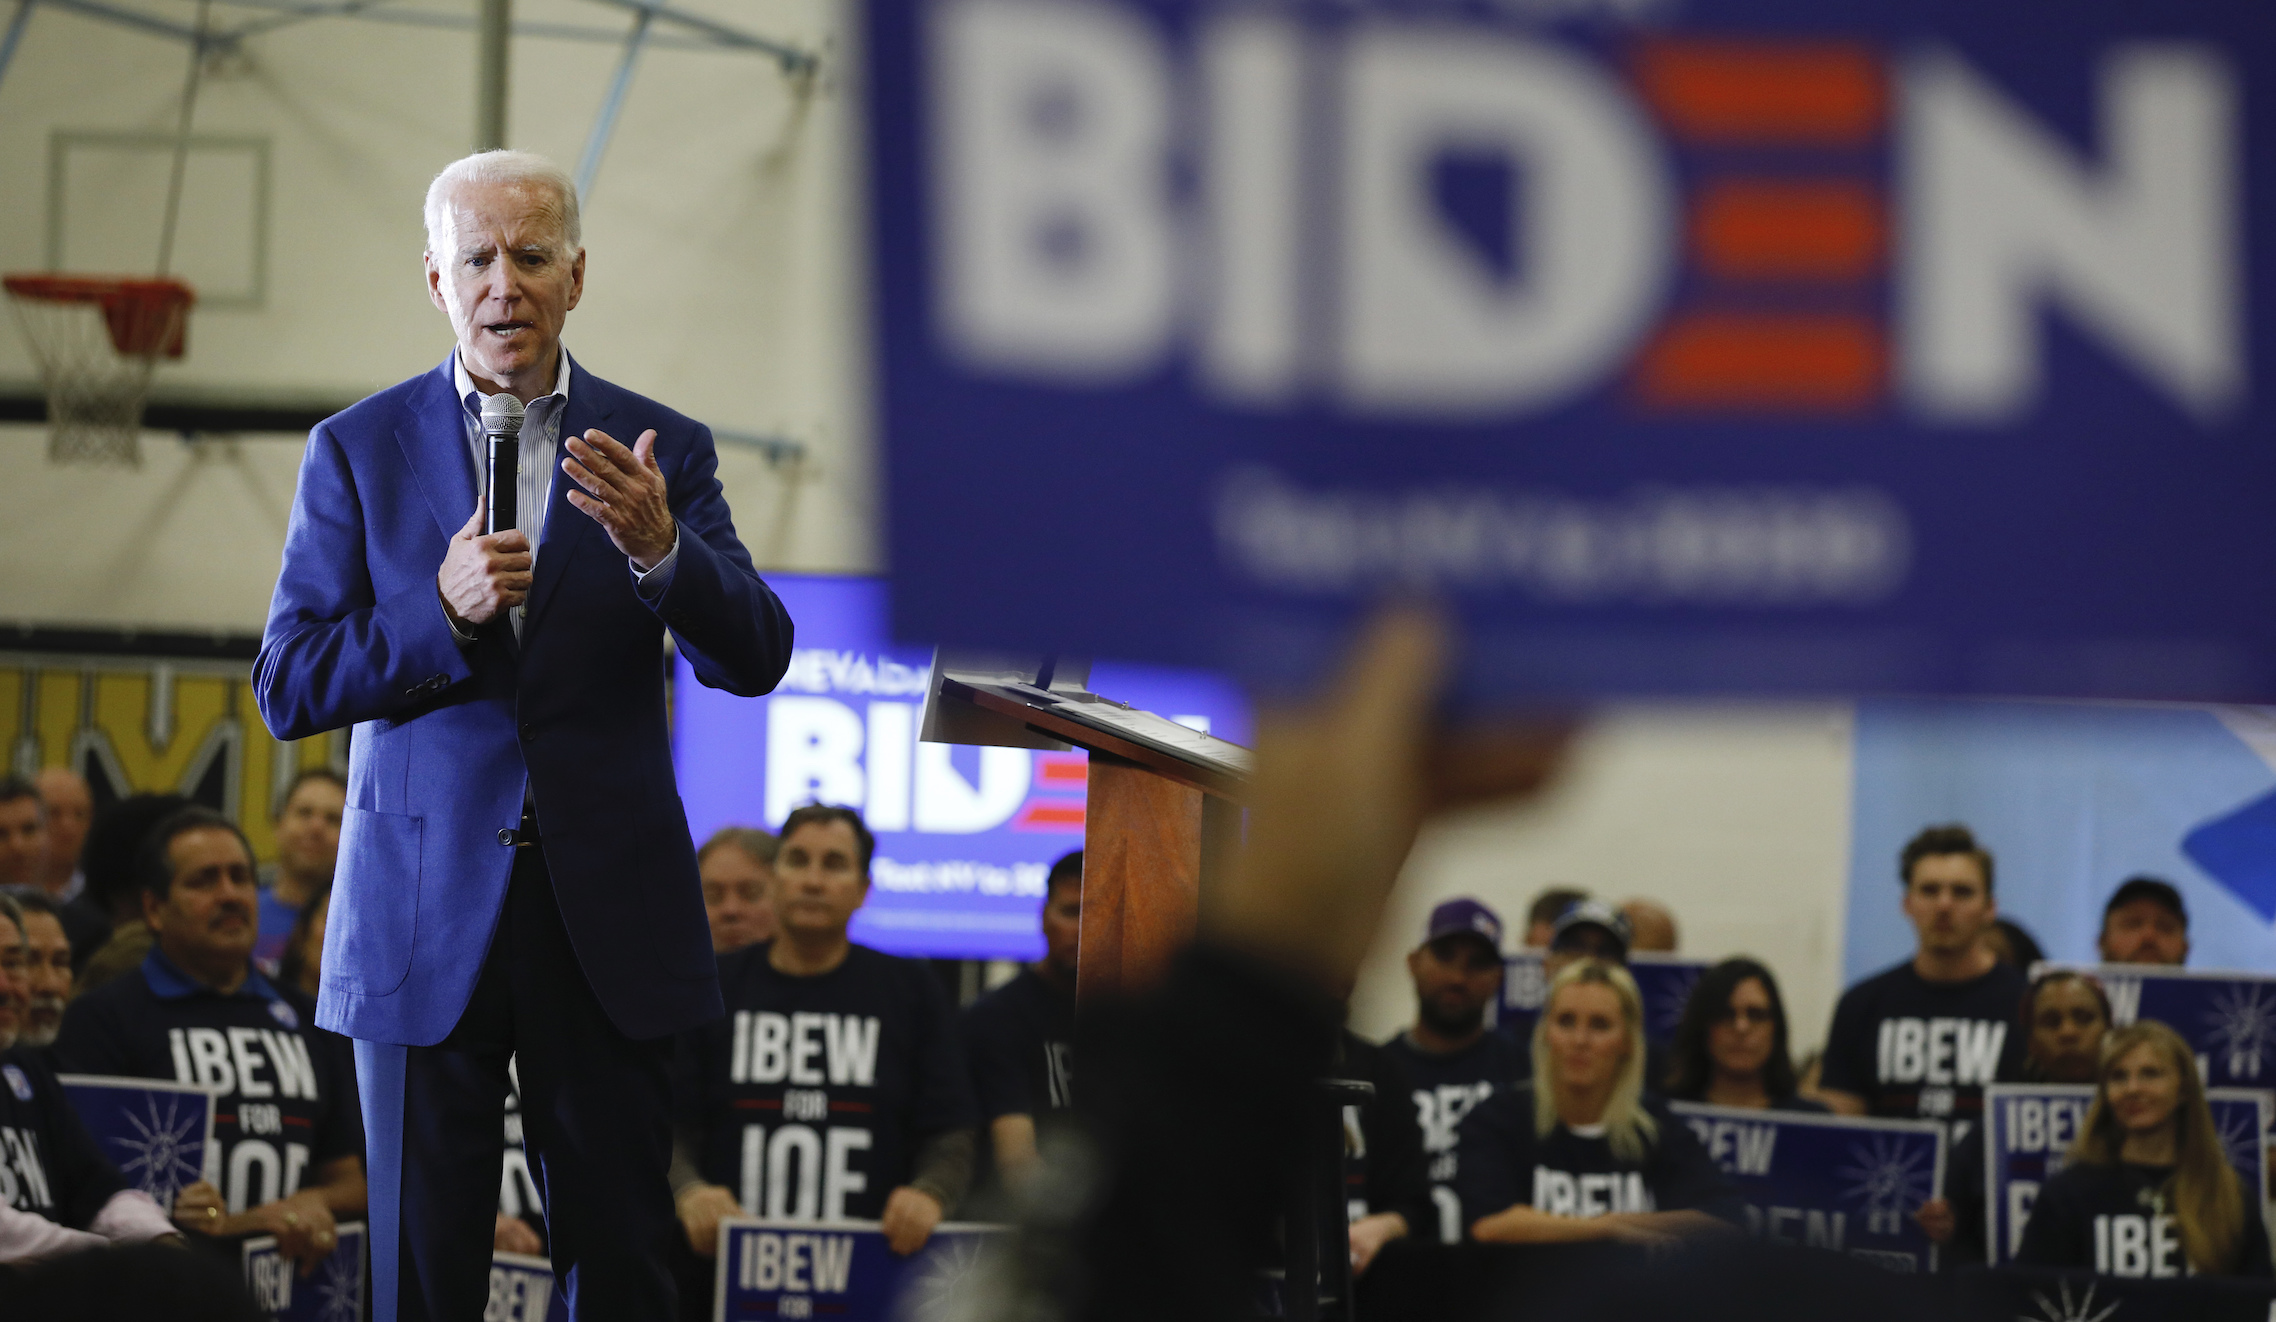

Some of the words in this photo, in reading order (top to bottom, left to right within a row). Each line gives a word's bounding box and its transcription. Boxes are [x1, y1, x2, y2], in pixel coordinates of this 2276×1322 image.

[930, 2, 2244, 415] BIDEN
[764, 695, 1090, 834] BIDE
[169, 1026, 318, 1101] IBEW
[731, 1010, 880, 1087] IBEW
[1878, 1017, 2008, 1086] IBEW
[238, 1103, 282, 1135] FOR
[783, 1089, 828, 1120] FOR
[1688, 1119, 1777, 1177] EW
[739, 1231, 853, 1293] IBEW
[2094, 1214, 2197, 1278] IBE
